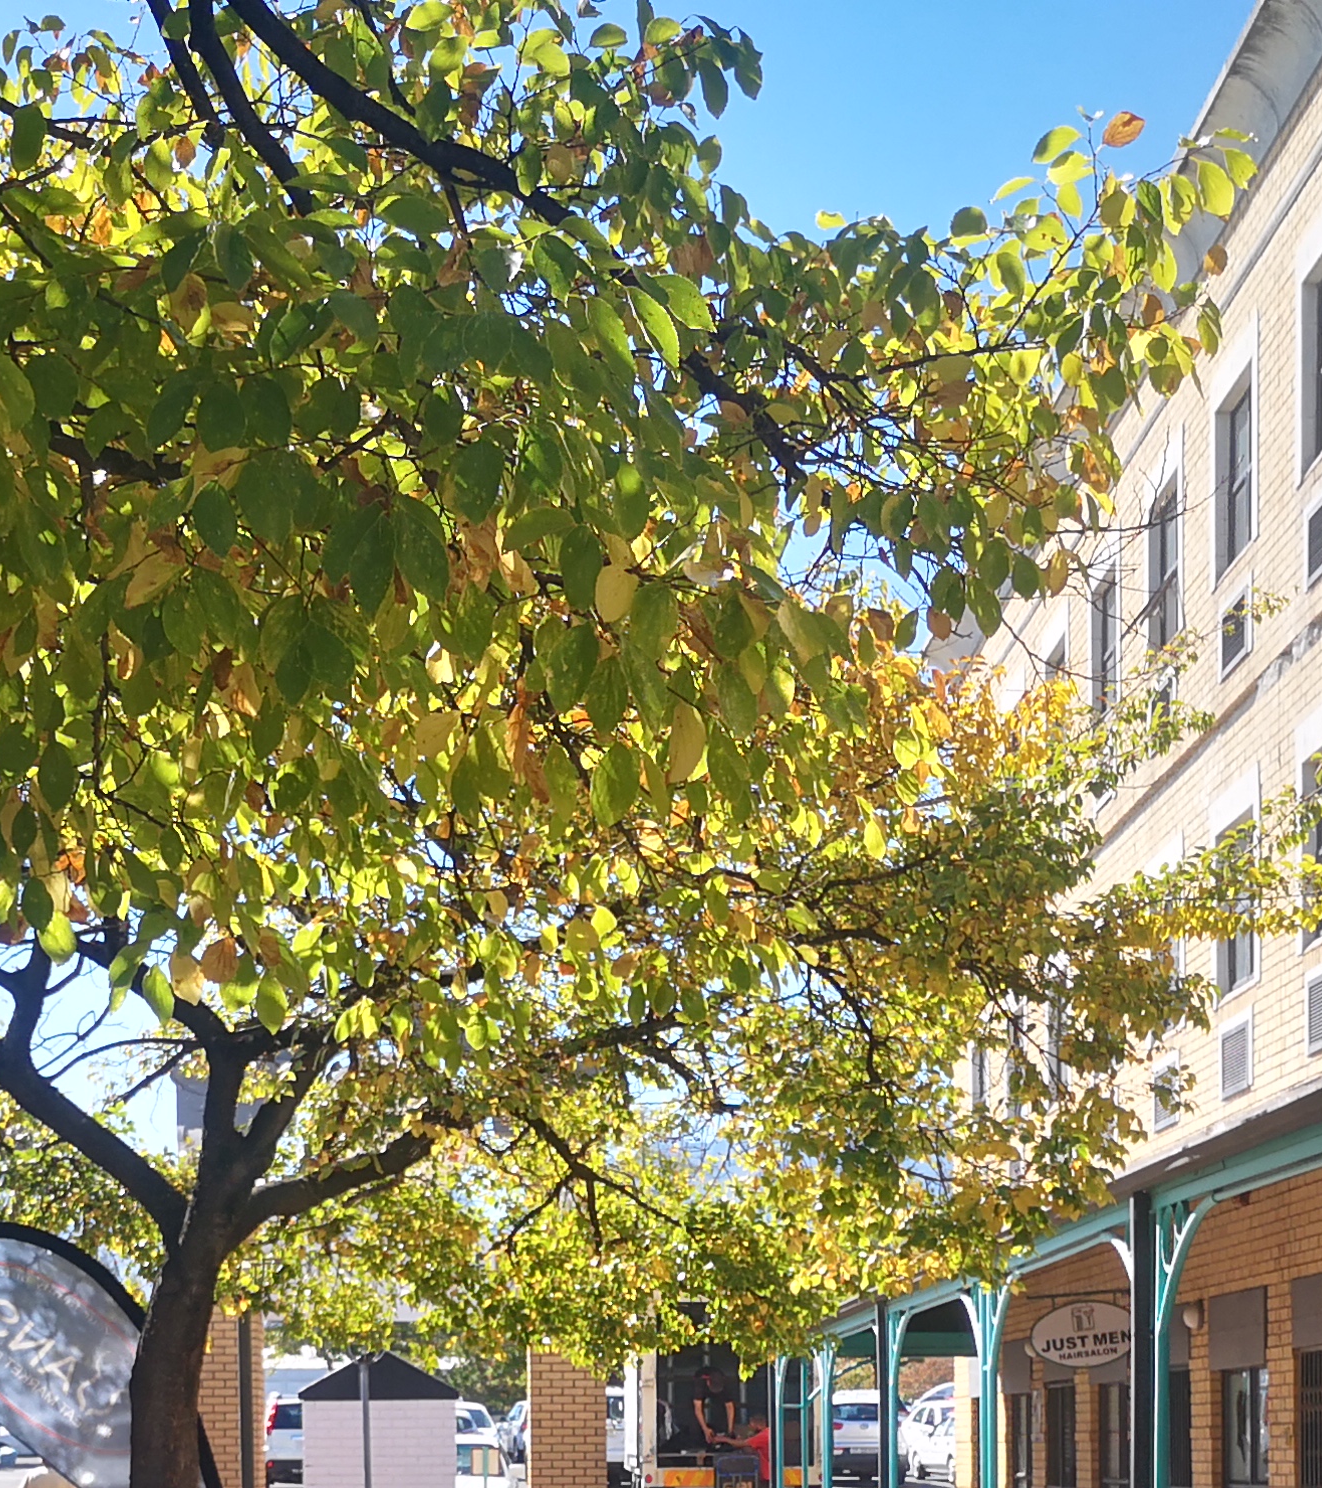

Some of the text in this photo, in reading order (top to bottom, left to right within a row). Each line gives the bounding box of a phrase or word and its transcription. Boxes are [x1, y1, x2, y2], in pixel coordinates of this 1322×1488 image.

[1041, 1330, 1132, 1353] JUST MEN
[1059, 1347, 1117, 1360] HAIRSALON
